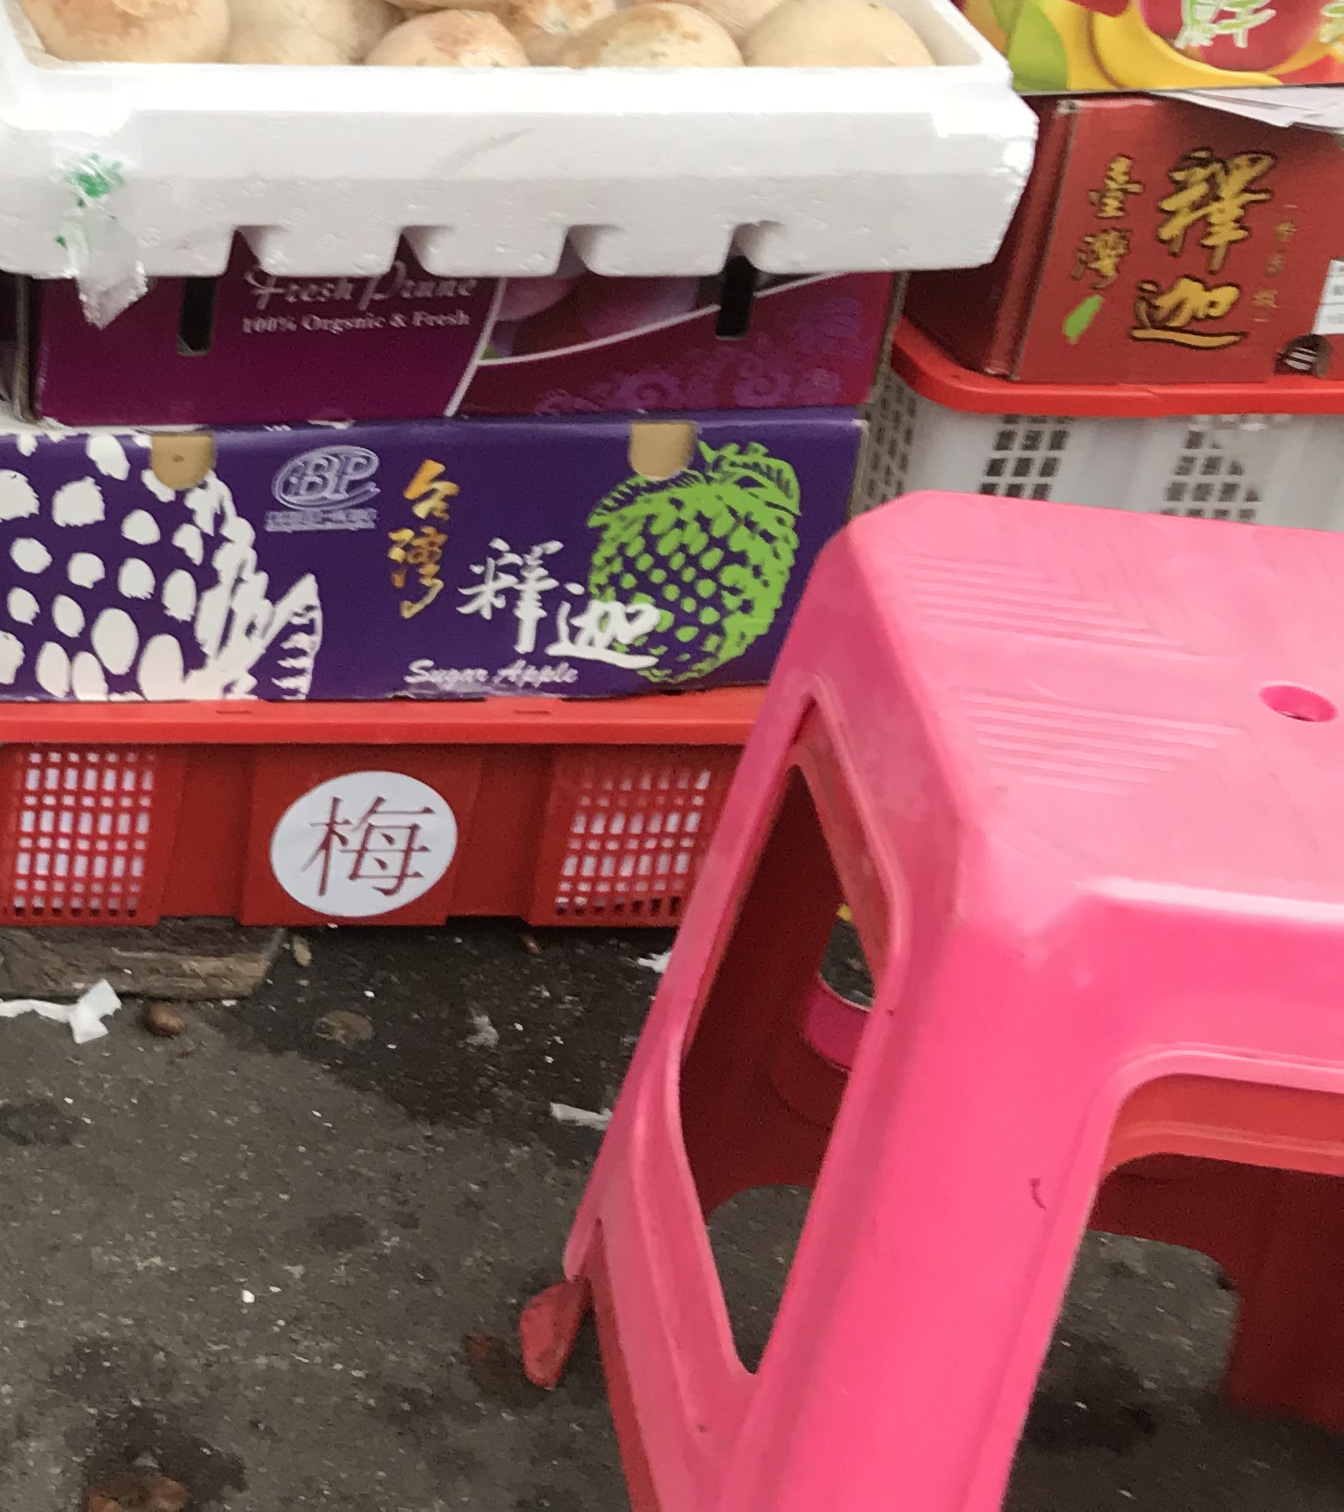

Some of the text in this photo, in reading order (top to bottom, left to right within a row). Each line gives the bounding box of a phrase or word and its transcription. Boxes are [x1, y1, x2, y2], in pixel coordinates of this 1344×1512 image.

[242, 315, 297, 334] 100%
[389, 314, 408, 329] &
[413, 309, 471, 327] Fresh
[404, 658, 579, 687] Sugar Apple
[308, 794, 436, 899] 梅
